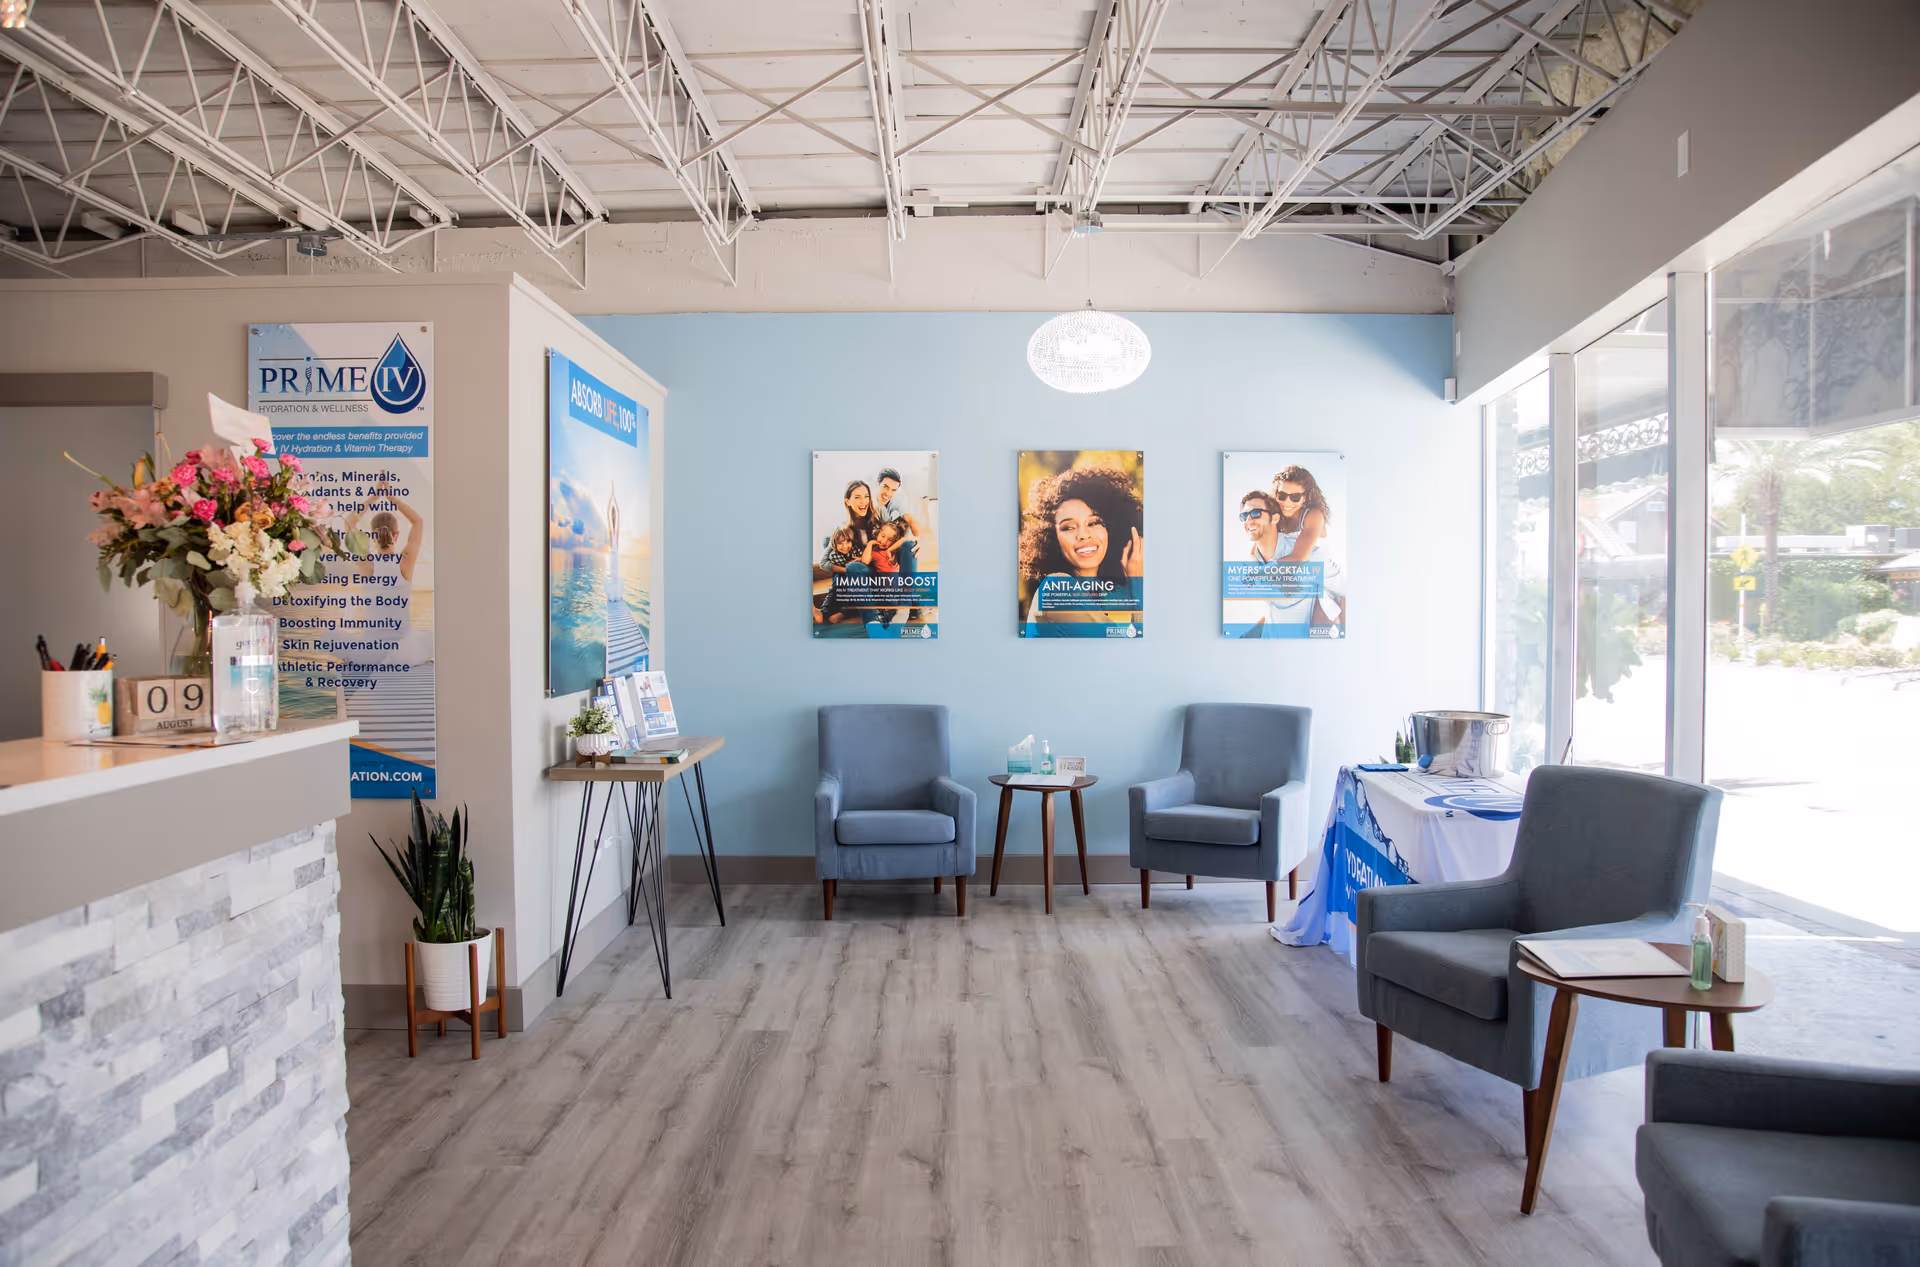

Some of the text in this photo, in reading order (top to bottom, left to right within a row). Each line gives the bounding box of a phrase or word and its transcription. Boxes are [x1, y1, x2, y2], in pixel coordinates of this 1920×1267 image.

[381, 366, 416, 393] IV
[258, 404, 369, 414] HYDRATION & WELLNESS
[570, 376, 602, 418] ABSORB
[619, 406, 636, 434] 100%
[296, 432, 310, 441] the
[312, 432, 346, 440] endless
[348, 431, 383, 440] benefits
[384, 431, 423, 442] provided
[280, 444, 289, 453] IV
[290, 444, 333, 455] Hydration
[334, 444, 342, 453] &
[344, 444, 376, 452] Vitamin
[378, 444, 413, 454] Therapy
[342, 471, 401, 483] Minerals,
[304, 486, 410, 497] xidants & Amino
[337, 501, 365, 514] help
[369, 501, 398, 511] with
[344, 552, 403, 564] Recovery
[1264, 566, 1310, 574] COCKTAIL
[353, 574, 398, 586] Energy
[836, 576, 936, 586] IMMUNITY BOOST
[1042, 581, 1114, 591] ANTI-AGING
[350, 596, 372, 606] the
[376, 596, 408, 608] Body
[280, 618, 402, 630] Boosting Immunity
[283, 640, 399, 652] Skin Rejuvenation
[327, 662, 410, 672] Performance
[306, 677, 377, 689] & Recovery
[157, 719, 194, 729] AUGUST
